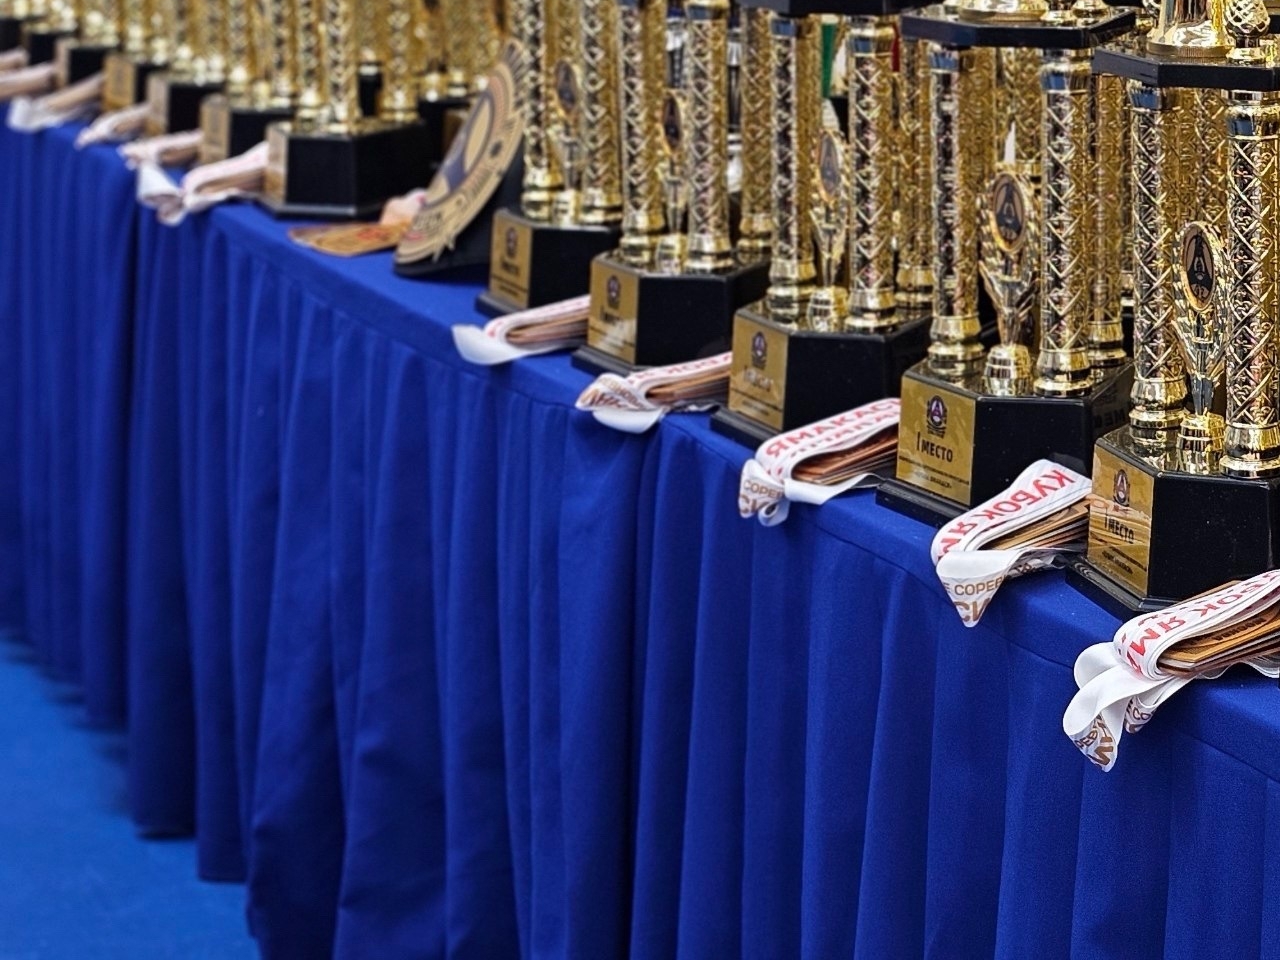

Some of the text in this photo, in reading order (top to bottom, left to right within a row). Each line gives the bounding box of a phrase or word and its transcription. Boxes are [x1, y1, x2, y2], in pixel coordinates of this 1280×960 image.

[921, 438, 954, 463] МЕСТО
[971, 469, 1076, 520] КУБОК
[1108, 518, 1135, 545] МЕСТО
